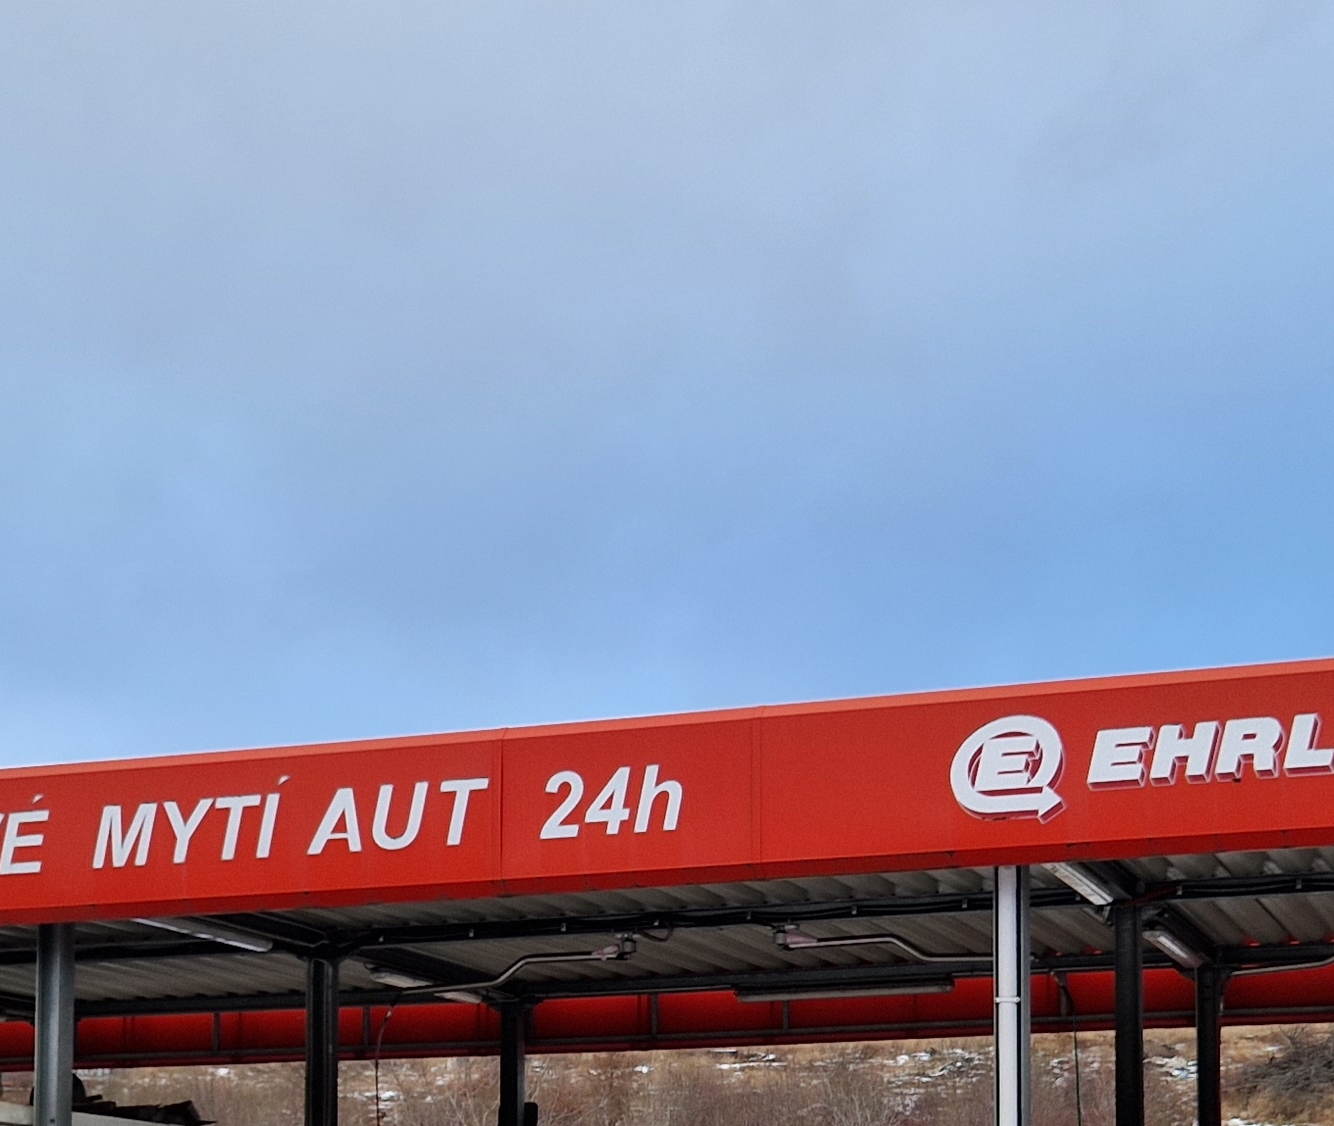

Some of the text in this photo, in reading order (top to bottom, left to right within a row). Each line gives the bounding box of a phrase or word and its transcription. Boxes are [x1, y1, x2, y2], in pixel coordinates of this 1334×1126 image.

[92, 775, 291, 869] MYTÍ
[307, 777, 489, 856] AUT
[539, 764, 684, 841] 24h
